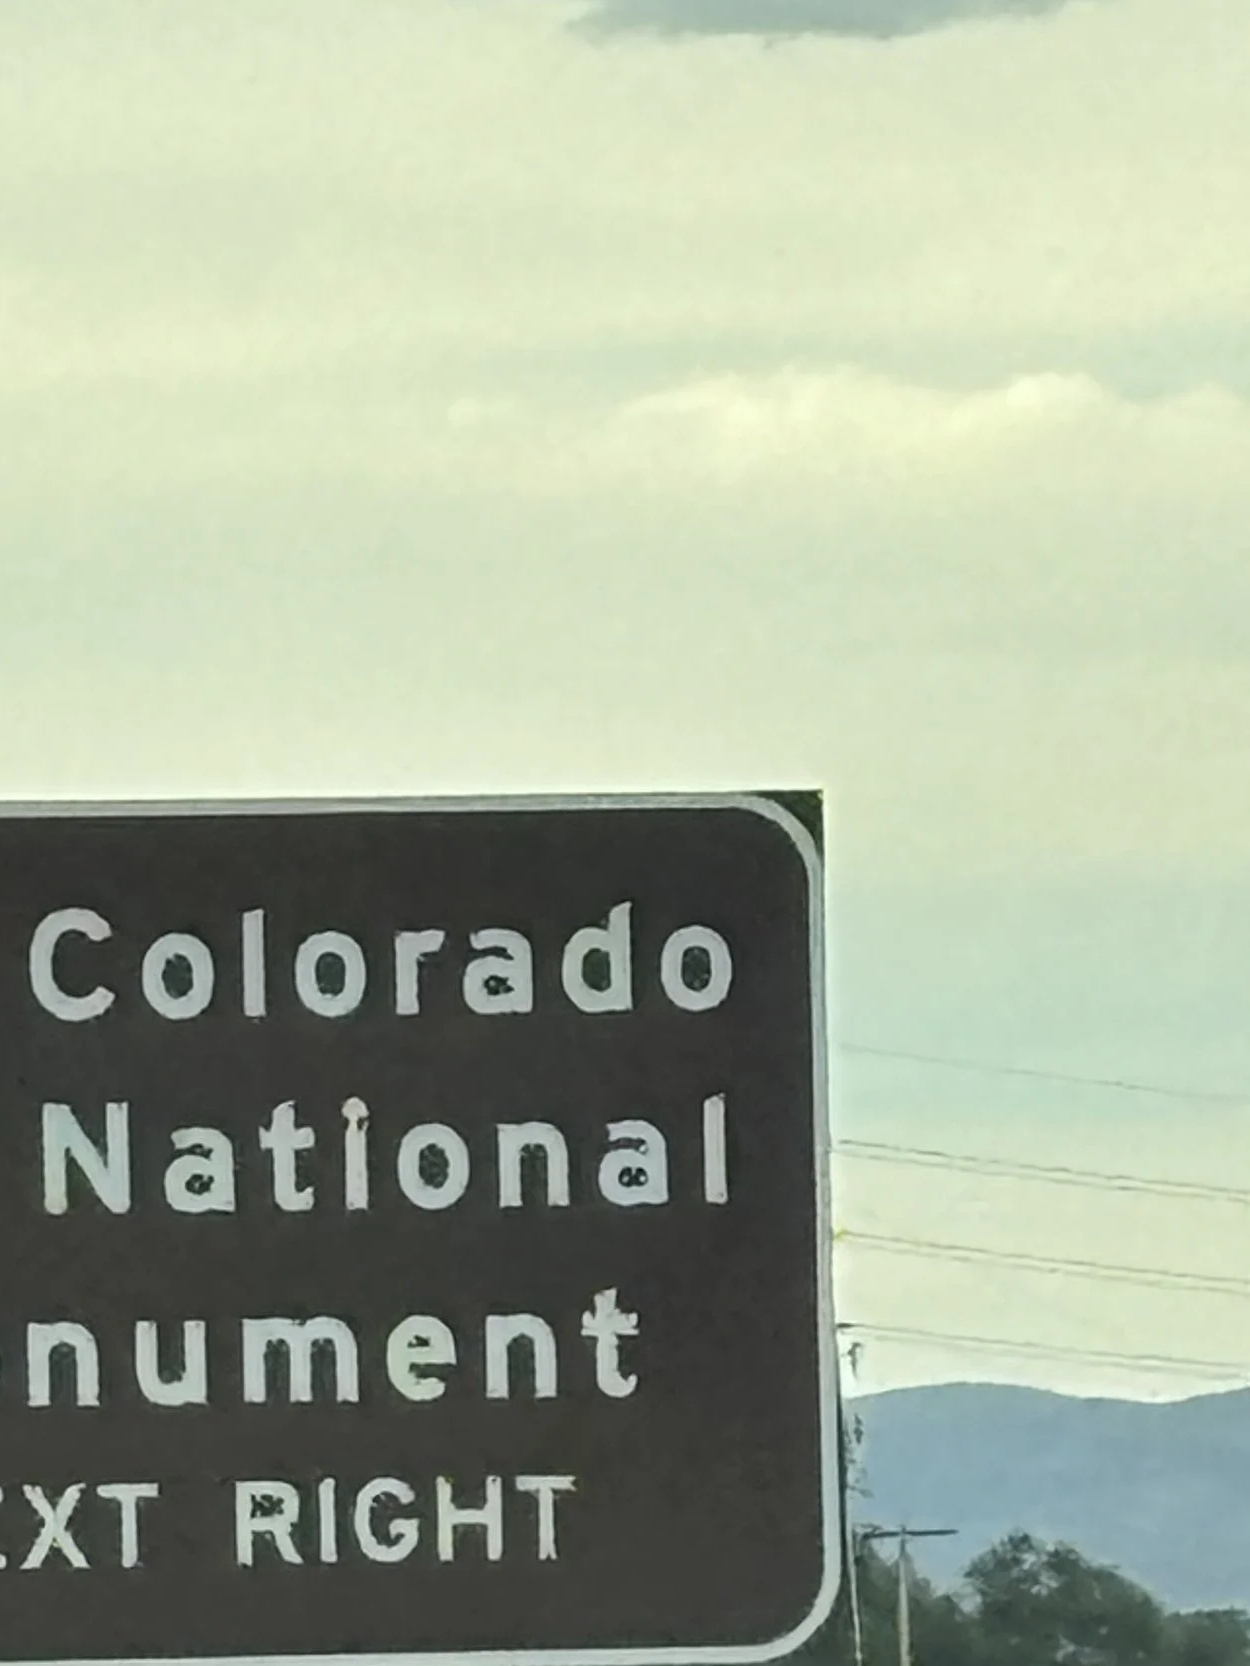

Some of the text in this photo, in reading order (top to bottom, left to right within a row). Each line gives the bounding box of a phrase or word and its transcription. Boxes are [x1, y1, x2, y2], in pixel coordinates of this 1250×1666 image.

[29, 902, 732, 1022] Colorado
[42, 1096, 728, 1214] National
[235, 1475, 576, 1567] RIGHT
